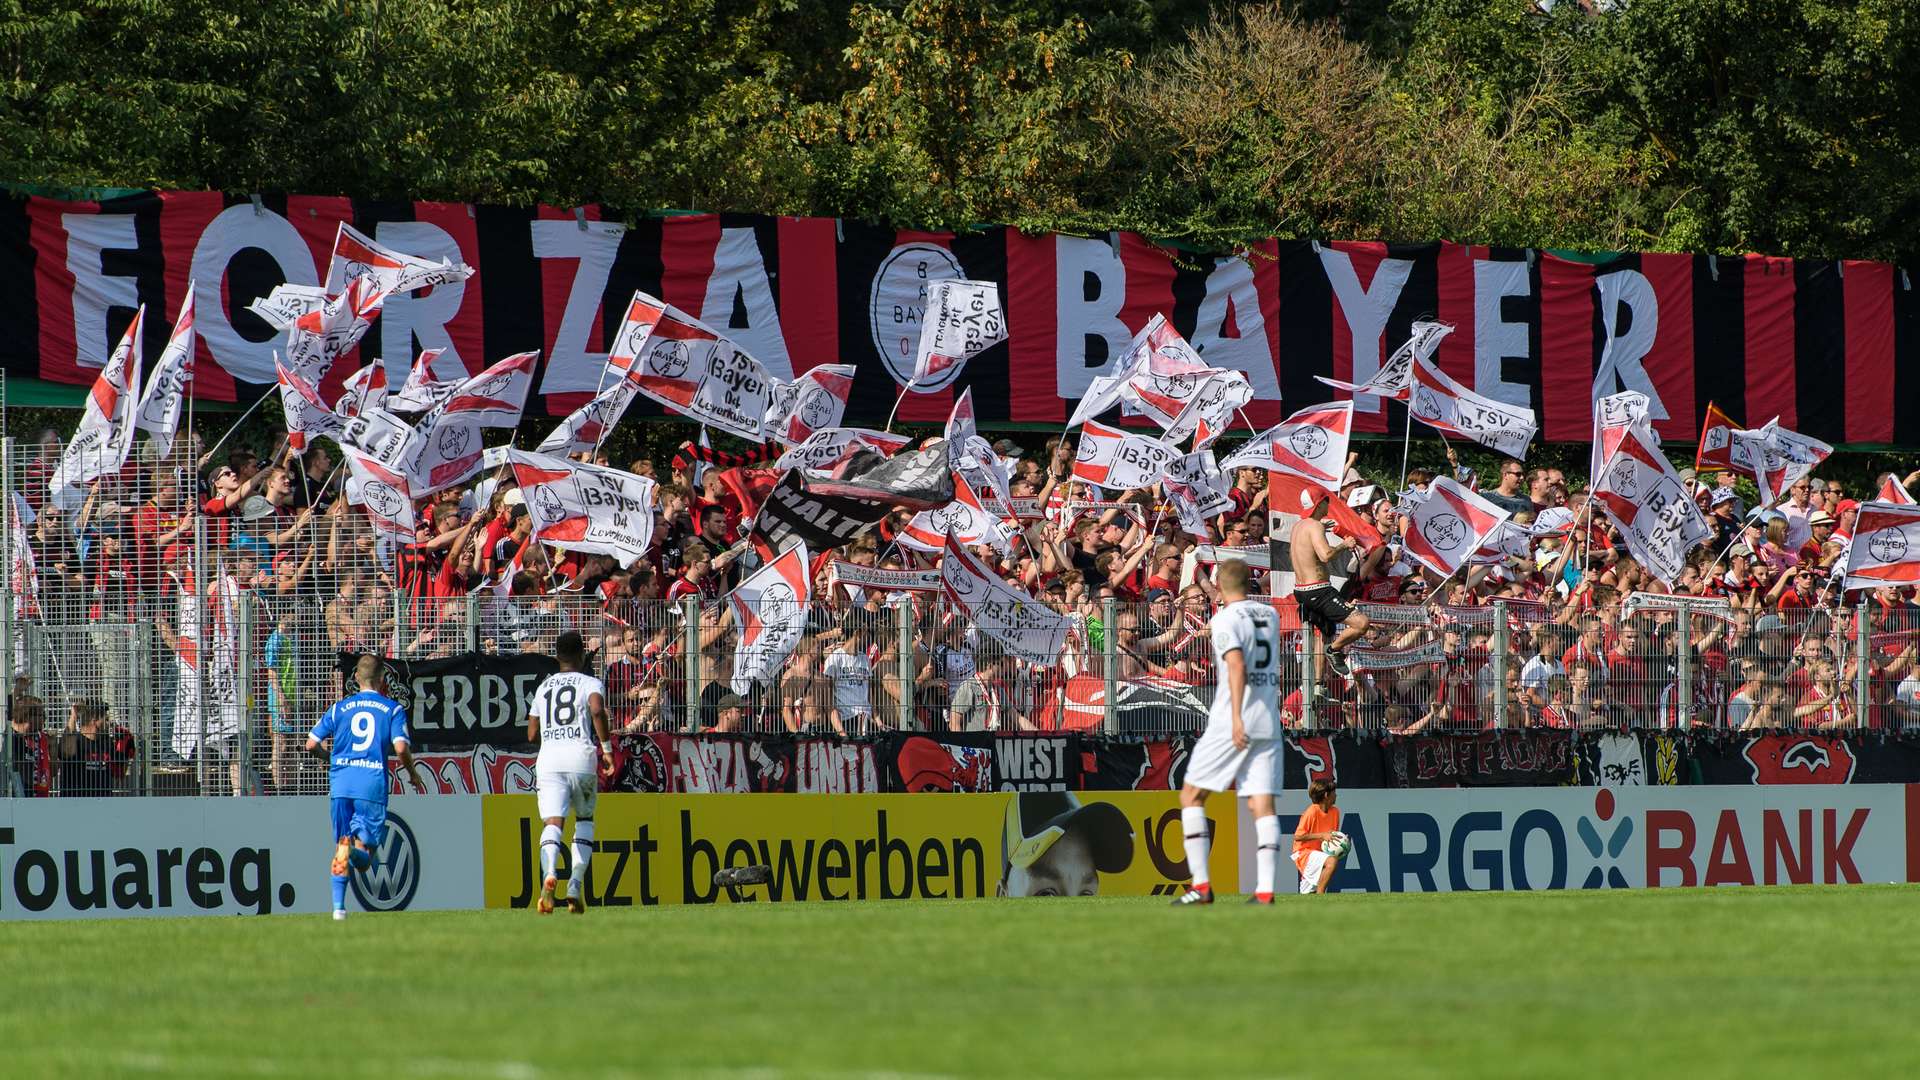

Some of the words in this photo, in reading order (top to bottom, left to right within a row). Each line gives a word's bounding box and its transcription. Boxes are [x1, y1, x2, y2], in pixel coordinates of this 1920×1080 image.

[62, 203, 797, 395] FORZA
[1055, 234, 1672, 421] BAYER
[655, 349, 687, 368] BAYER
[710, 357, 765, 396] Bayer
[698, 398, 759, 429] Leverkusen
[1476, 408, 1511, 429] TSV
[584, 488, 641, 514] Bayer
[596, 474, 626, 494] TSV
[1872, 538, 1906, 550] BAYER
[1254, 620, 1272, 669] 5
[543, 685, 576, 729] 18
[351, 711, 376, 752] 9
[567, 726, 582, 740] 04
[995, 737, 1067, 780] WEST
[681, 809, 985, 904] bewerben
[1645, 808, 1872, 888] BANK
